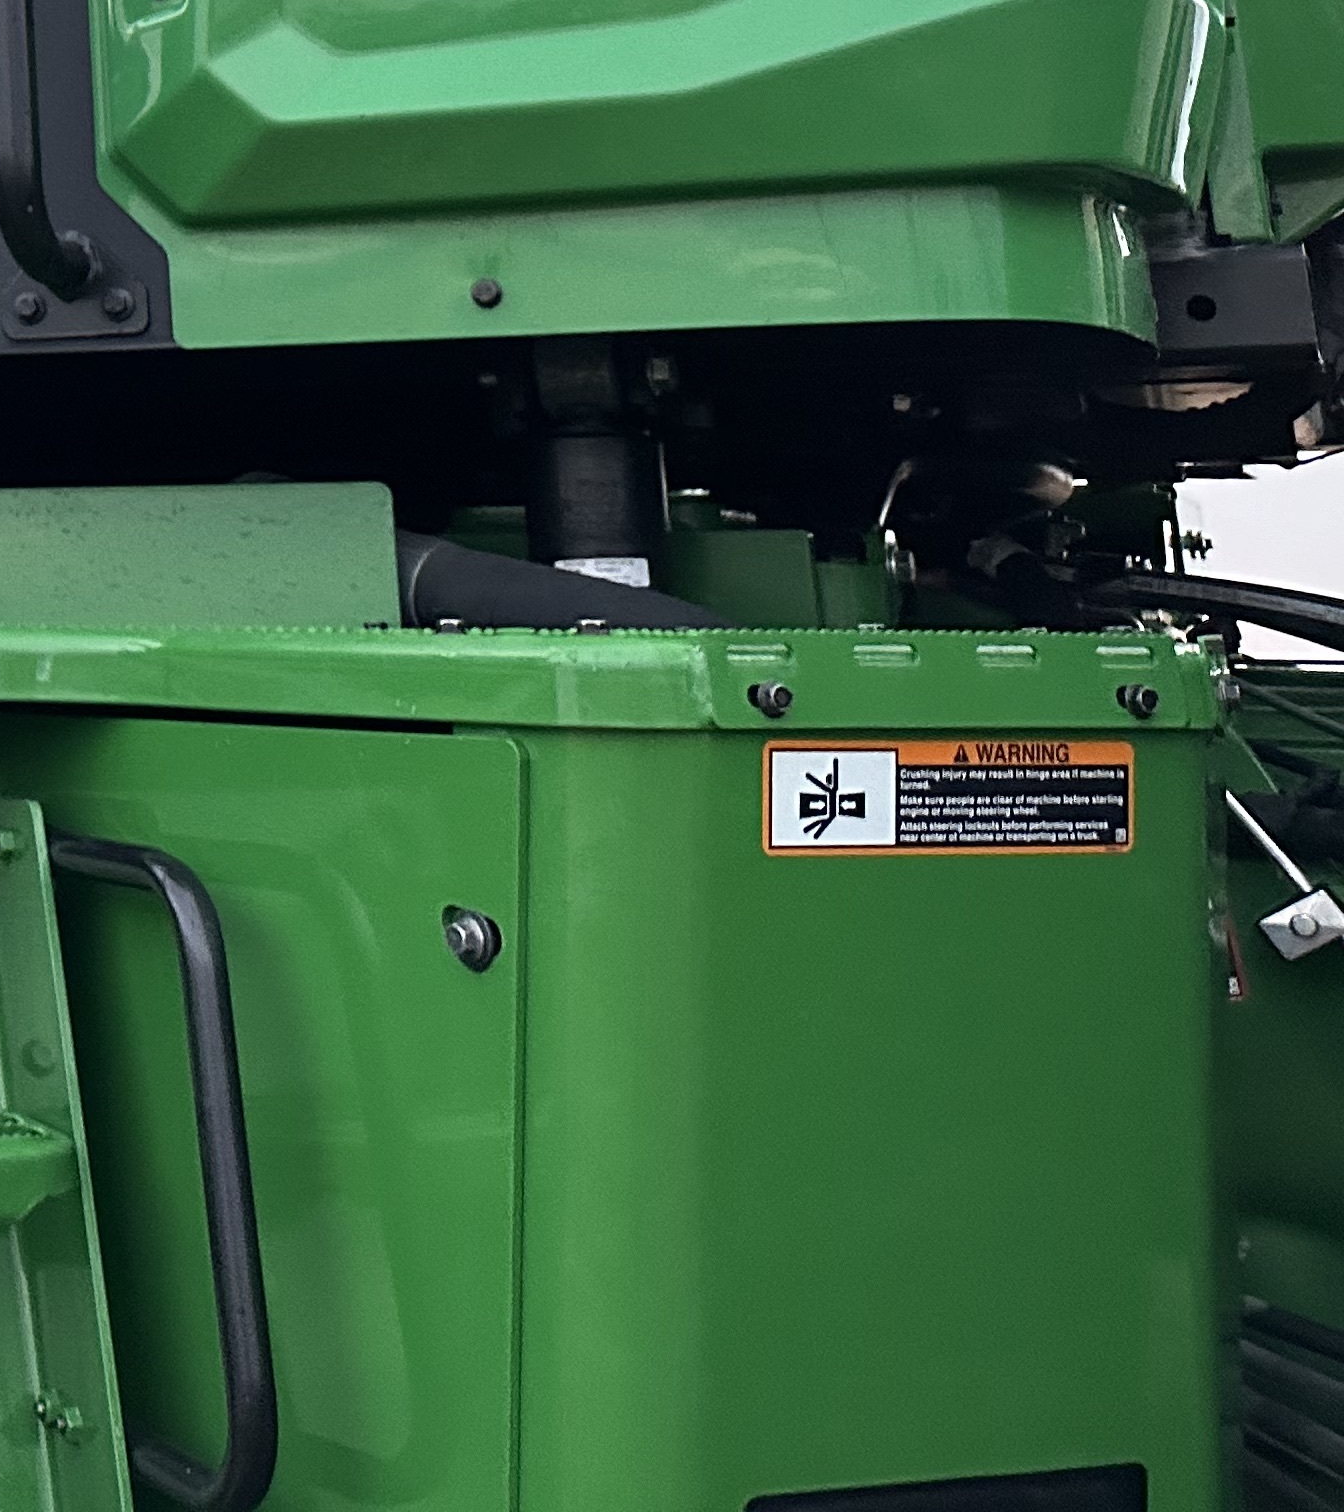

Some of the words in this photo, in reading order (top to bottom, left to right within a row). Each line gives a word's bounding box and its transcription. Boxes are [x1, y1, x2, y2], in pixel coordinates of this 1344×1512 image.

[976, 744, 1069, 763] WARNING
[900, 769, 940, 781] Crushing
[942, 769, 967, 781] injury
[969, 770, 986, 780] may
[1016, 769, 1024, 778] in
[1026, 768, 1050, 780] hinge
[1080, 770, 1114, 779] machine
[900, 795, 922, 804] Make
[946, 796, 974, 806] people
[993, 796, 1013, 804] clear
[1016, 795, 1024, 804] of
[1026, 795, 1061, 805] machine
[1063, 794, 1089, 805] before
[900, 807, 929, 818] engine
[943, 807, 974, 817] moving
[976, 807, 1010, 817] steering
[900, 822, 927, 830] Attach
[930, 822, 962, 832] steering
[1002, 821, 1027, 830] before
[1029, 820, 1073, 831] performing
[921, 833, 946, 841] center
[949, 833, 957, 841] of
[959, 833, 993, 841] machine
